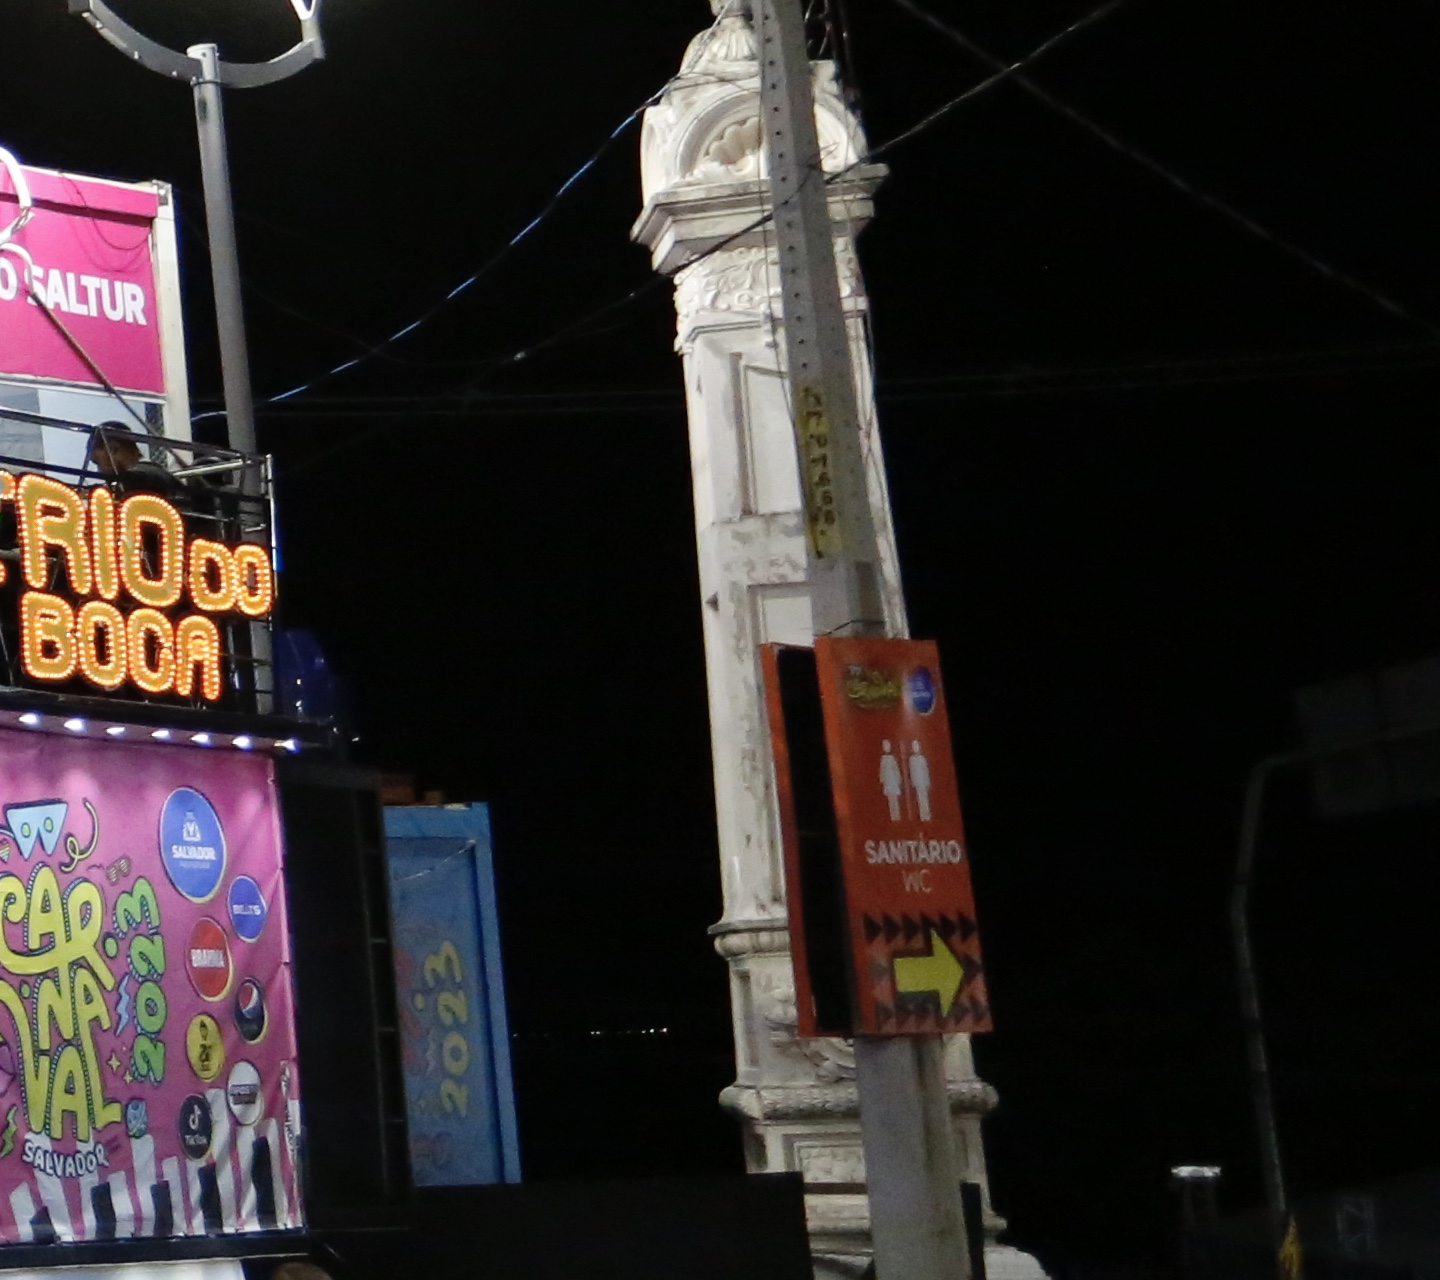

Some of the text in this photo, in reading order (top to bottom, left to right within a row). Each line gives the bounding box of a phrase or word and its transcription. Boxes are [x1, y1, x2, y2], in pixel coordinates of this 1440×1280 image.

[24, 263, 148, 327] SALTUR
[188, 537, 273, 617] DO
[21, 590, 222, 702] BOCA
[170, 844, 217, 862] SALVADOR
[863, 832, 963, 866] SANITÁRIO
[900, 869, 933, 894] WC
[113, 876, 168, 1085] 2023
[21, 1137, 110, 1179] SALVADOR
